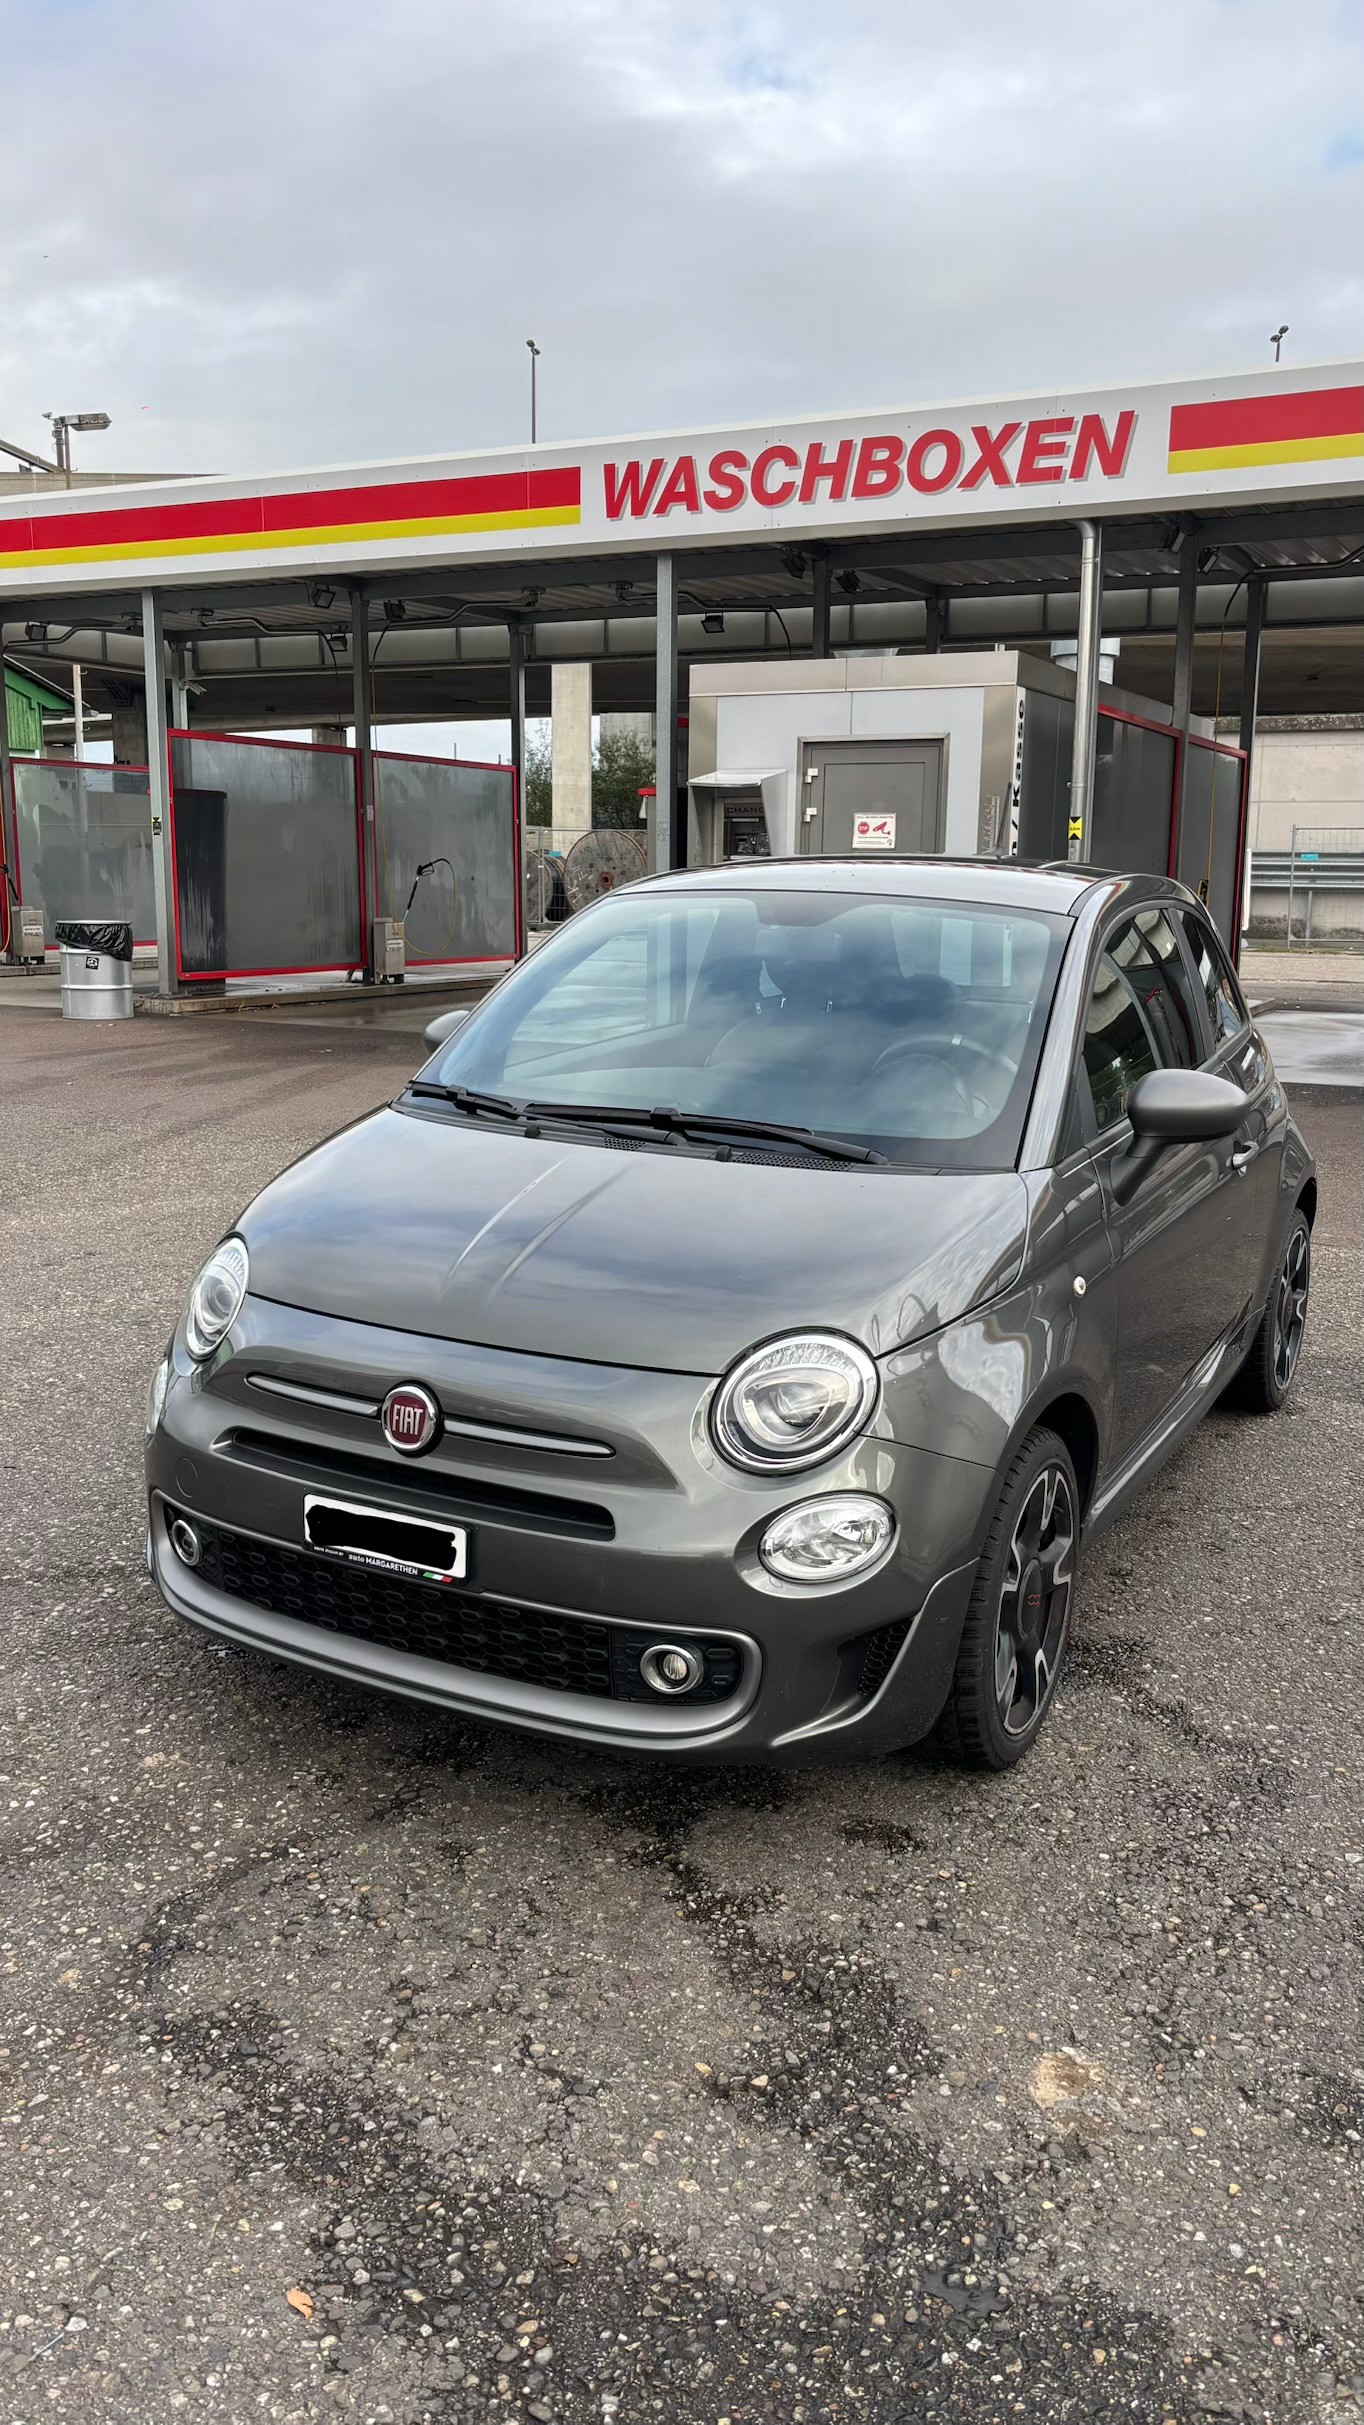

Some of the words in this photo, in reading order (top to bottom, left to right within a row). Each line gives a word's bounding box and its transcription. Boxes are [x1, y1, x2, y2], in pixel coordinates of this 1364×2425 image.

[604, 411, 1135, 520] WASCHBOXEN
[392, 1403, 424, 1436] FIAT
[365, 1556, 418, 1576] MARGARETHEN
